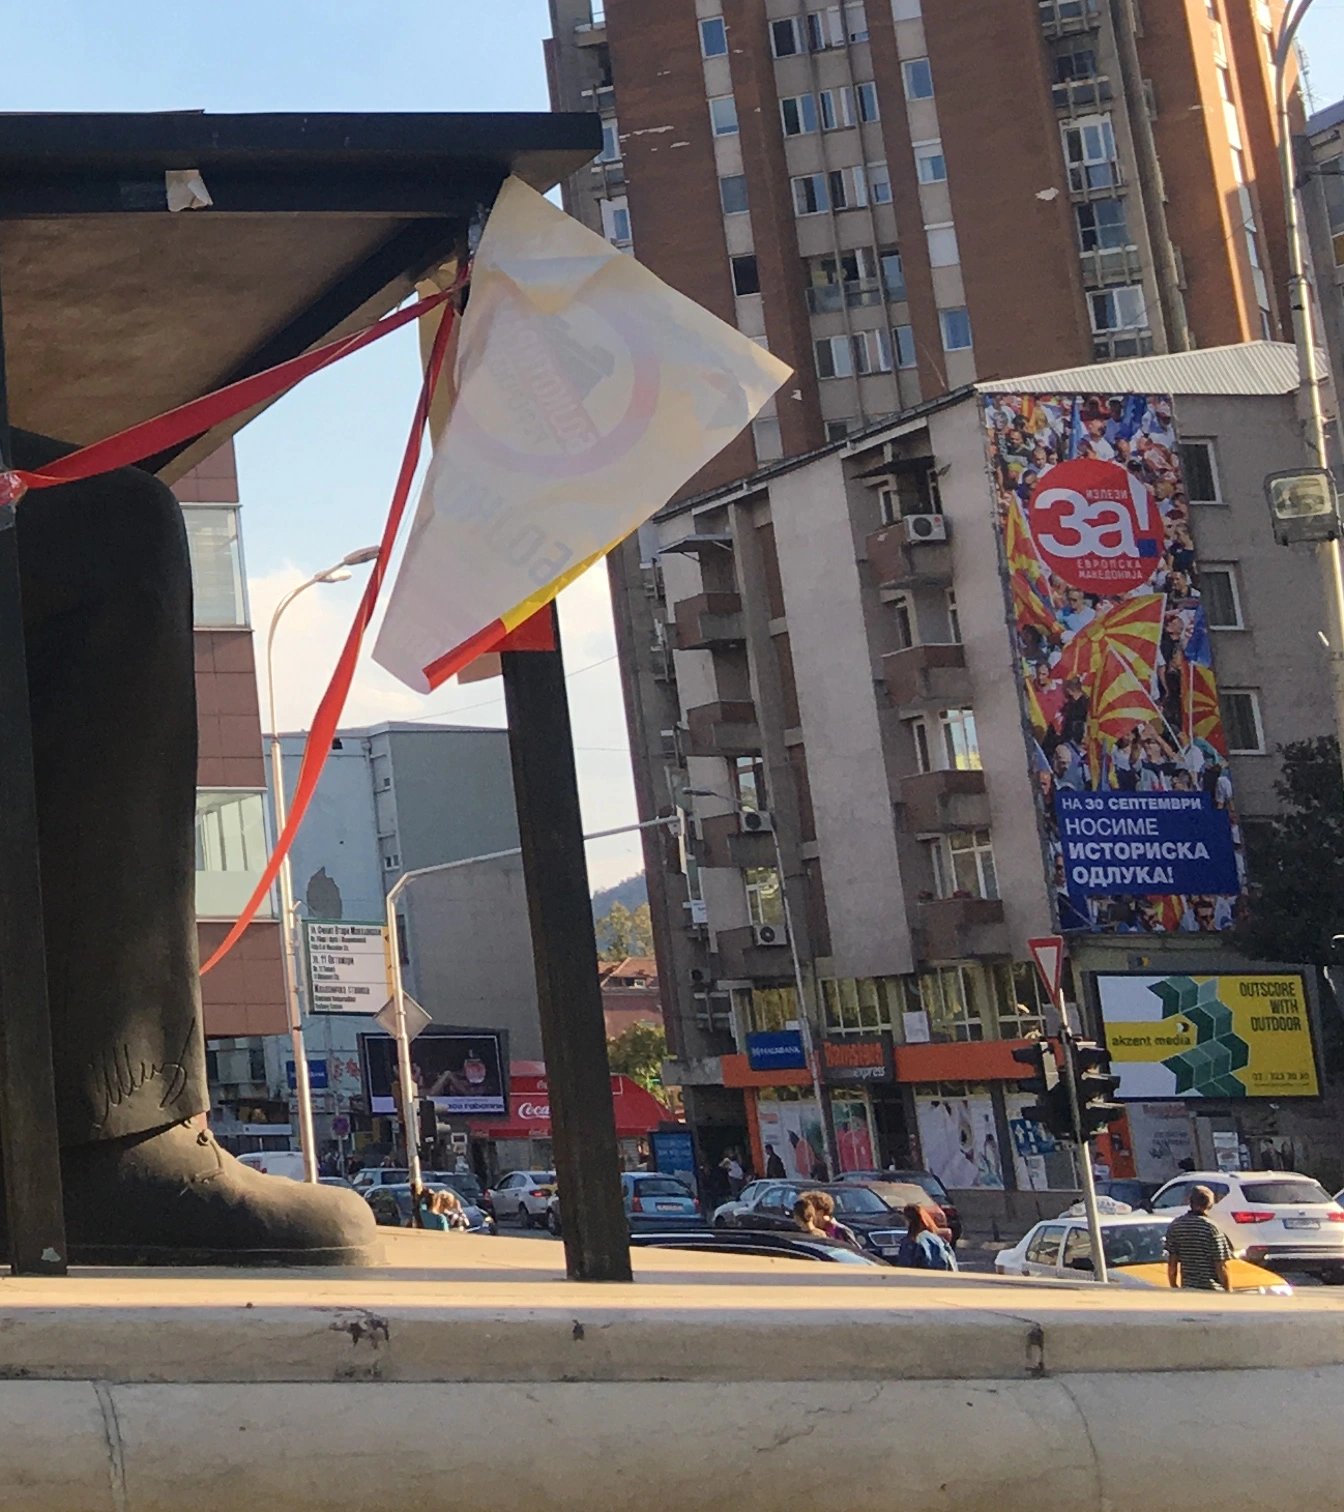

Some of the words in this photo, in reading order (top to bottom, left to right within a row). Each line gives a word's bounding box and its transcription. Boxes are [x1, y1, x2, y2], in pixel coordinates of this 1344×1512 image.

[1085, 489, 1128, 500] ИЗЛЕЗИ
[1077, 559, 1142, 569] ЕВРОПСКА
[1078, 570, 1143, 580] МАКЕДОНИЈА
[1062, 798, 1082, 810] НА
[1085, 798, 1104, 810] 30
[1108, 798, 1202, 810] СЕПТЕМВРИ
[1065, 818, 1160, 836] НОСИМЕ
[1068, 841, 1210, 860] ИСТОРИСКА
[1072, 866, 1174, 887] ОДЛУКА!
[1239, 982, 1296, 997] OUTSCORE
[1269, 999, 1299, 1014] WITH
[1250, 1016, 1302, 1032] OUTDOOR
[1112, 1035, 1152, 1047] akzent
[1155, 1035, 1191, 1046] media
